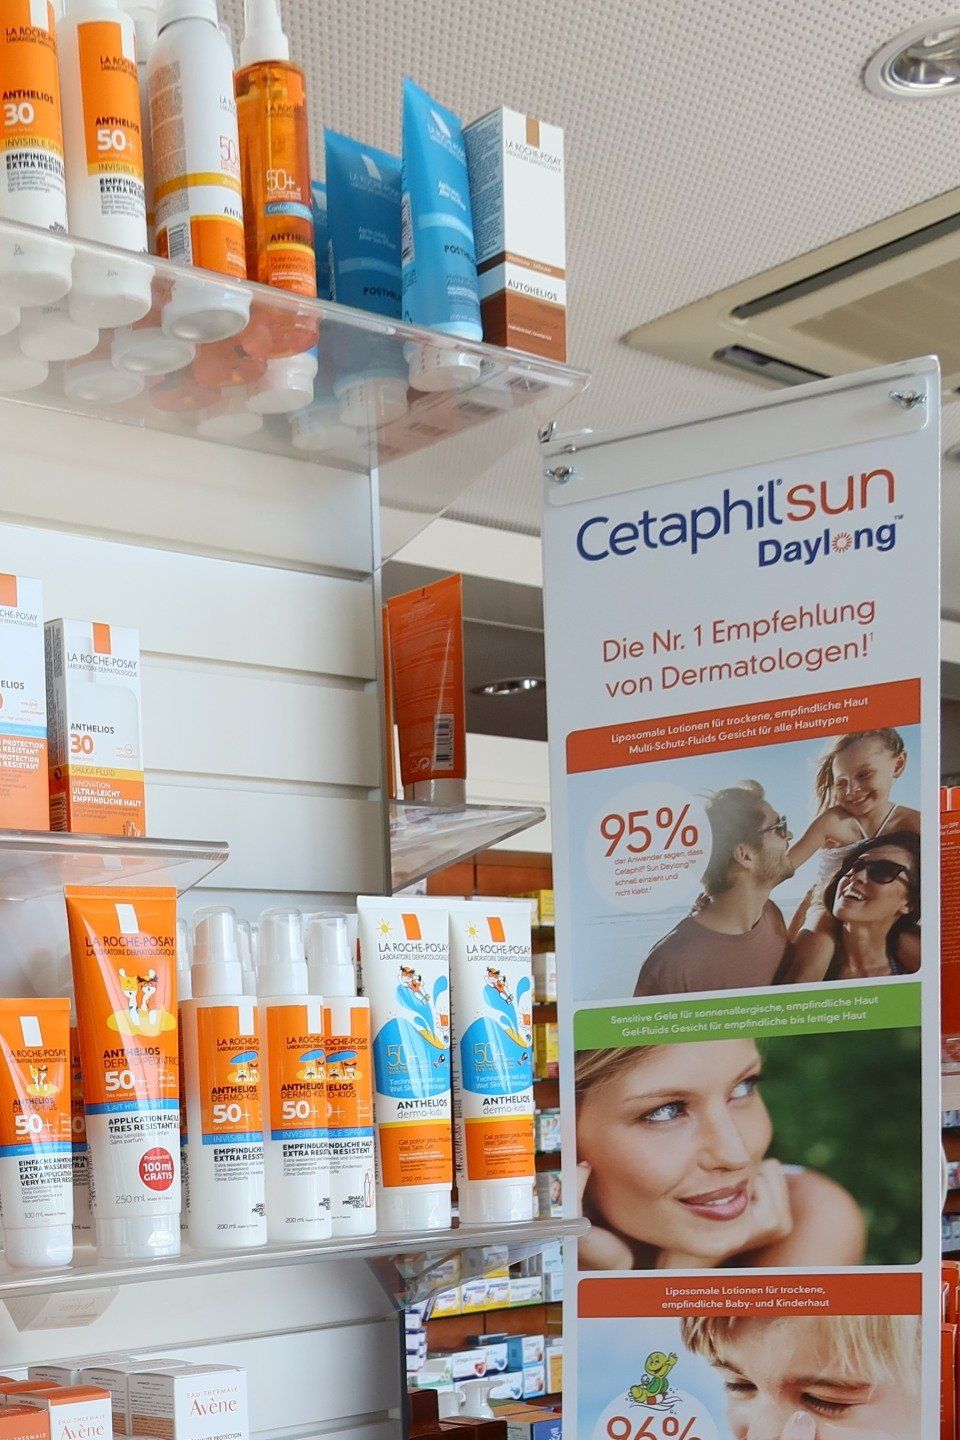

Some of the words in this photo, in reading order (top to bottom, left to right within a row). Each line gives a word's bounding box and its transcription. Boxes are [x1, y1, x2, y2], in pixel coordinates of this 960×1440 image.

[2, 89, 54, 105] ANTHELIOS
[4, 102, 34, 126] 30
[97, 128, 135, 151] 50+
[507, 277, 558, 303] AUTOHELIOS
[787, 468, 895, 522] sun
[603, 637, 644, 664] Die
[652, 630, 685, 655] Nr.
[694, 624, 702, 647] 1
[713, 600, 875, 645] Empfehlung
[605, 674, 652, 698] von
[611, 727, 666, 744] Liposomale
[668, 720, 710, 736] Lotionen
[712, 717, 725, 731] für
[727, 712, 772, 728] trockene,
[774, 700, 841, 721] empfindliche
[843, 696, 868, 709] Haut
[70, 733, 94, 756] 30
[629, 732, 717, 755] Multi-Schutz-Fluids
[718, 727, 757, 743] Gesicht
[759, 724, 772, 736] für
[774, 721, 792, 733] alle
[795, 714, 849, 732] Hauttypen
[601, 804, 698, 857] 95%
[611, 1014, 652, 1025] Sensitive
[680, 1009, 692, 1019] für
[786, 998, 851, 1012] empfindliche
[854, 995, 878, 1006] Haut
[671, 1022, 707, 1034] Gesicht
[709, 1021, 722, 1031] für
[724, 1016, 787, 1031] empfindliche
[790, 1015, 805, 1025] bis
[842, 1010, 866, 1021] Haut
[397, 1099, 448, 1110] ANTHELIOS
[483, 1096, 530, 1106] ANTHELIOS
[483, 1105, 526, 1115] dermo-kids
[397, 1108, 443, 1119] dermo-kids
[143, 1171, 173, 1182] GRATIS
[665, 1286, 720, 1296] Liposomale
[722, 1286, 763, 1295] Lotionen
[765, 1285, 778, 1294] für
[780, 1285, 826, 1295] trockene,
[662, 1300, 723, 1310] empfindliche
[725, 1299, 753, 1309] Baby-
[755, 1299, 774, 1307] und
[776, 1298, 829, 1307] Kinderhaut
[190, 1398, 237, 1418] Avène
[60, 1422, 105, 1440] Avène
